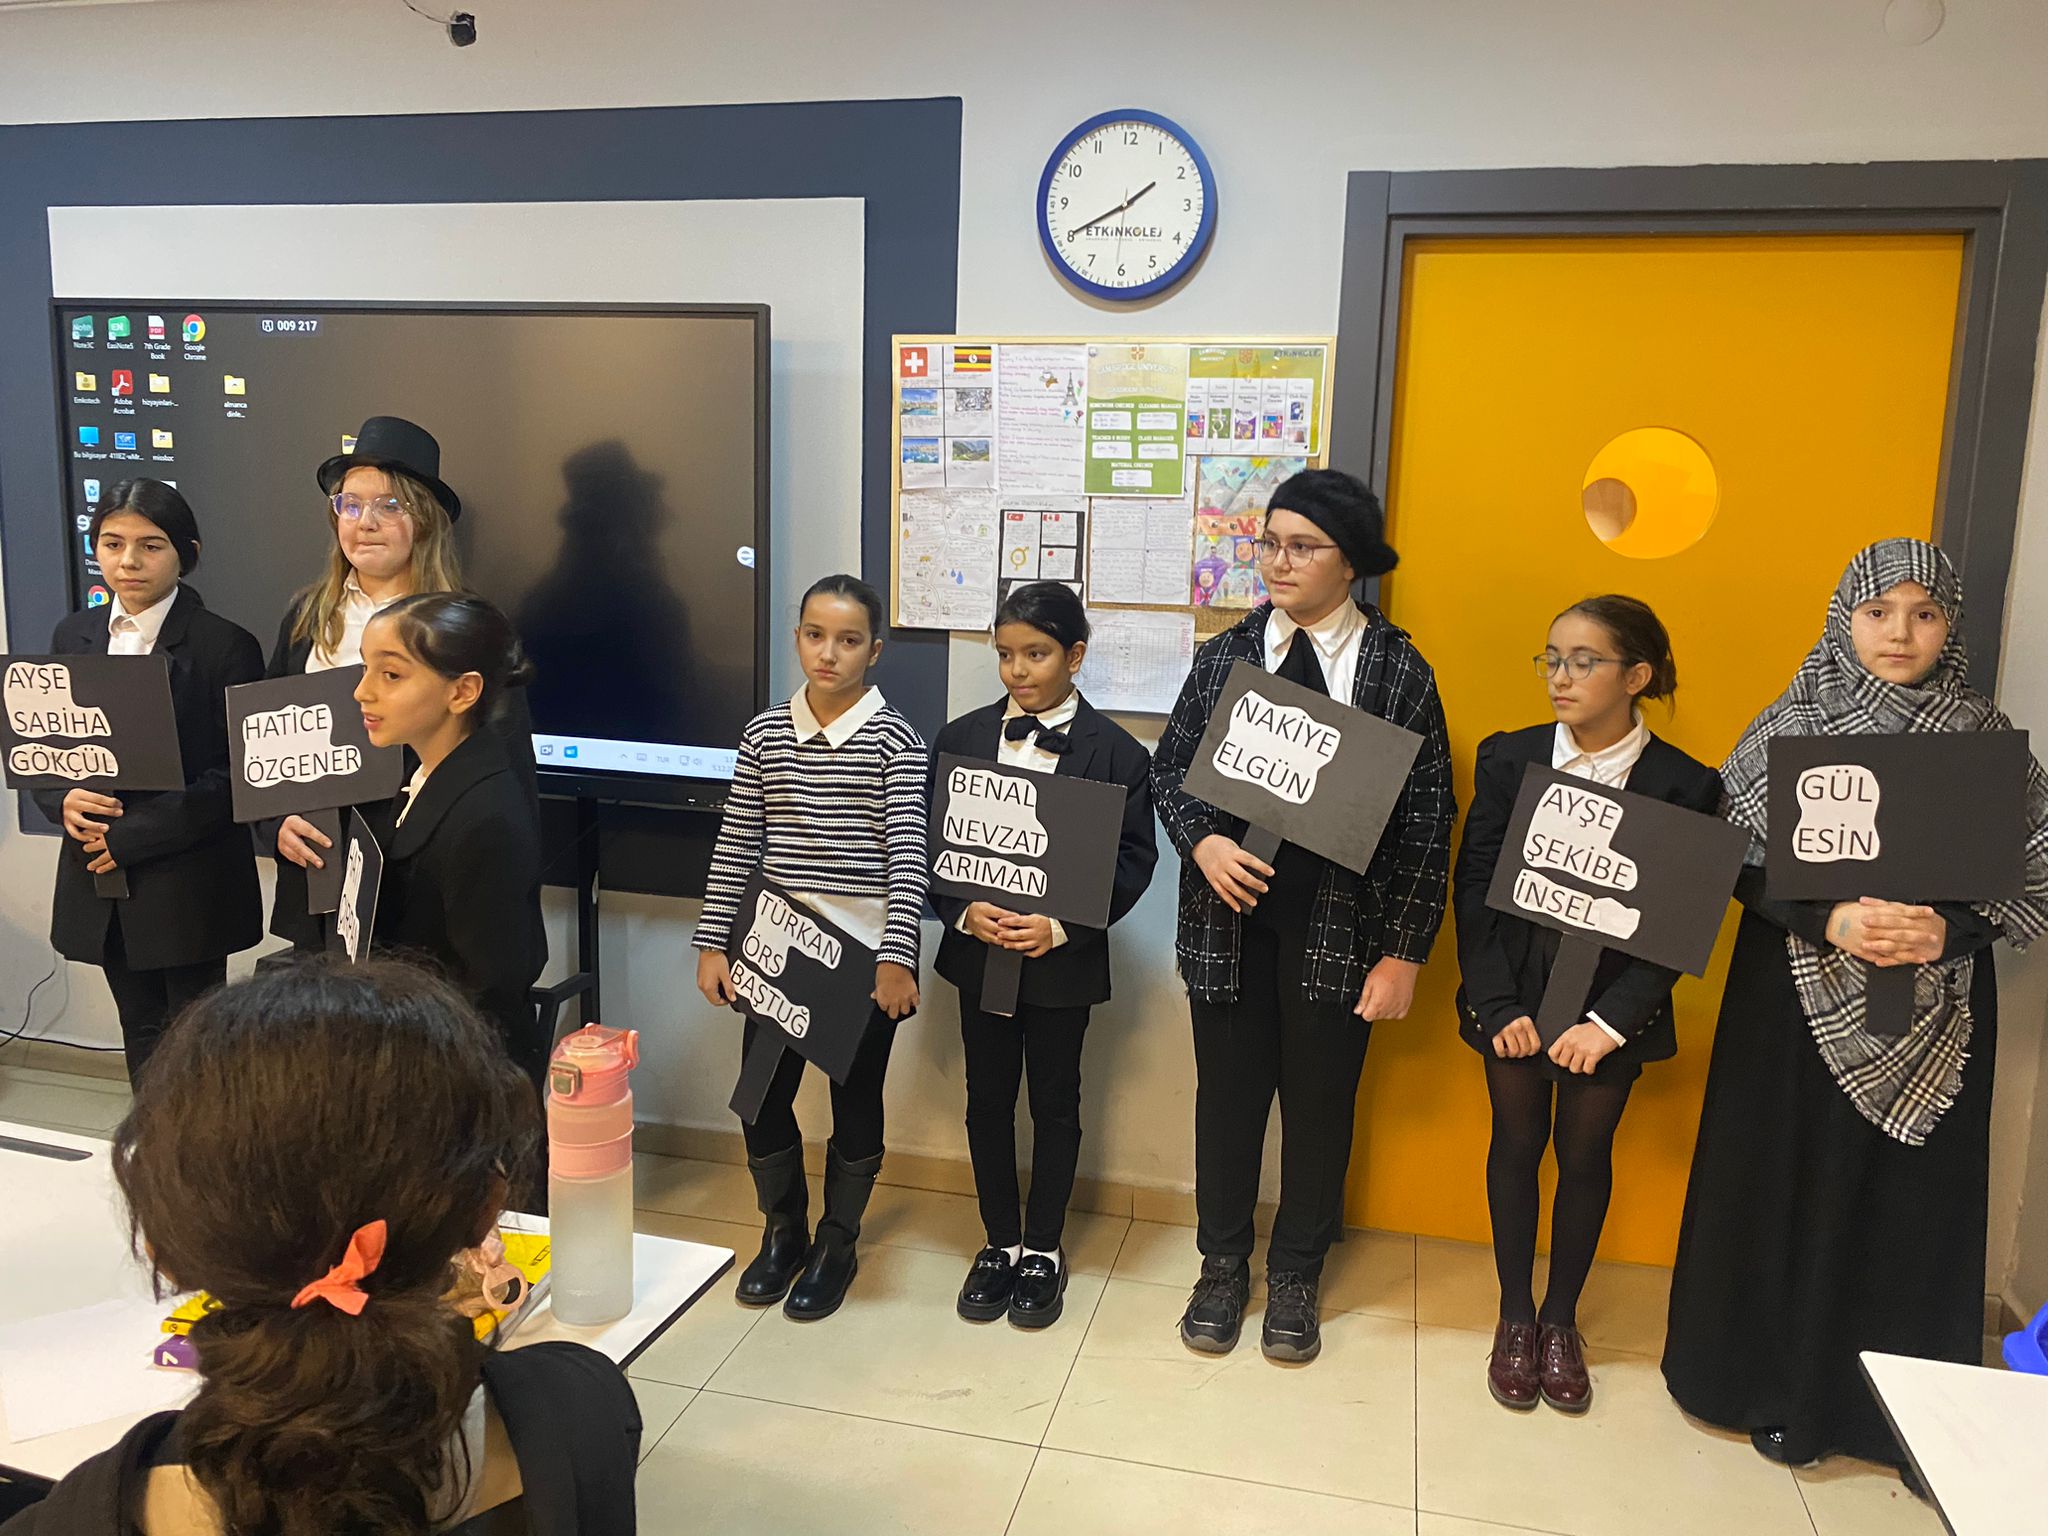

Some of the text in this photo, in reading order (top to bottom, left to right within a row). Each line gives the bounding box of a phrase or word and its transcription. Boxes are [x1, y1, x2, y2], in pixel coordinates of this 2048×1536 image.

[1094, 140, 1103, 154] 11
[1124, 131, 1138, 146] 12
[1158, 141, 1163, 155] 1
[1069, 164, 1082, 178] 10
[1177, 167, 1185, 180] 2
[1060, 197, 1069, 210] 9
[1183, 199, 1192, 212] 3
[1066, 230, 1075, 243] 8
[1172, 231, 1181, 245] 4
[1087, 254, 1096, 266] 7
[1117, 264, 1126, 277] 6
[1148, 255, 1157, 268] 5
[277, 320, 318, 331] 009 217
[184, 343, 206, 352] Google
[184, 353, 206, 361] Chrome
[113, 407, 136, 415] Acrobat
[8, 667, 67, 695] AYŞE
[14, 707, 109, 735] SABİHA
[245, 706, 329, 740] HATİCE
[1236, 696, 1337, 758] NAKİYE
[11, 745, 115, 778] GÖKÇÜL
[246, 747, 361, 783] ÖZGENER
[1216, 741, 1311, 799] ELGÜN
[952, 771, 1035, 808] BENAL
[1801, 768, 1873, 803] GÜL
[1542, 788, 1619, 830] AYŞE
[946, 816, 1047, 854] NEVZAT
[1797, 823, 1873, 856] ESİN
[936, 853, 1046, 895] ARIMAN
[1526, 833, 1632, 889] ŞEKİBE
[1515, 872, 1596, 926] İNSEL
[762, 893, 841, 966] TÜRKAN
[744, 930, 784, 975] ÖRS
[730, 963, 809, 1037] BAŞTUĞ
